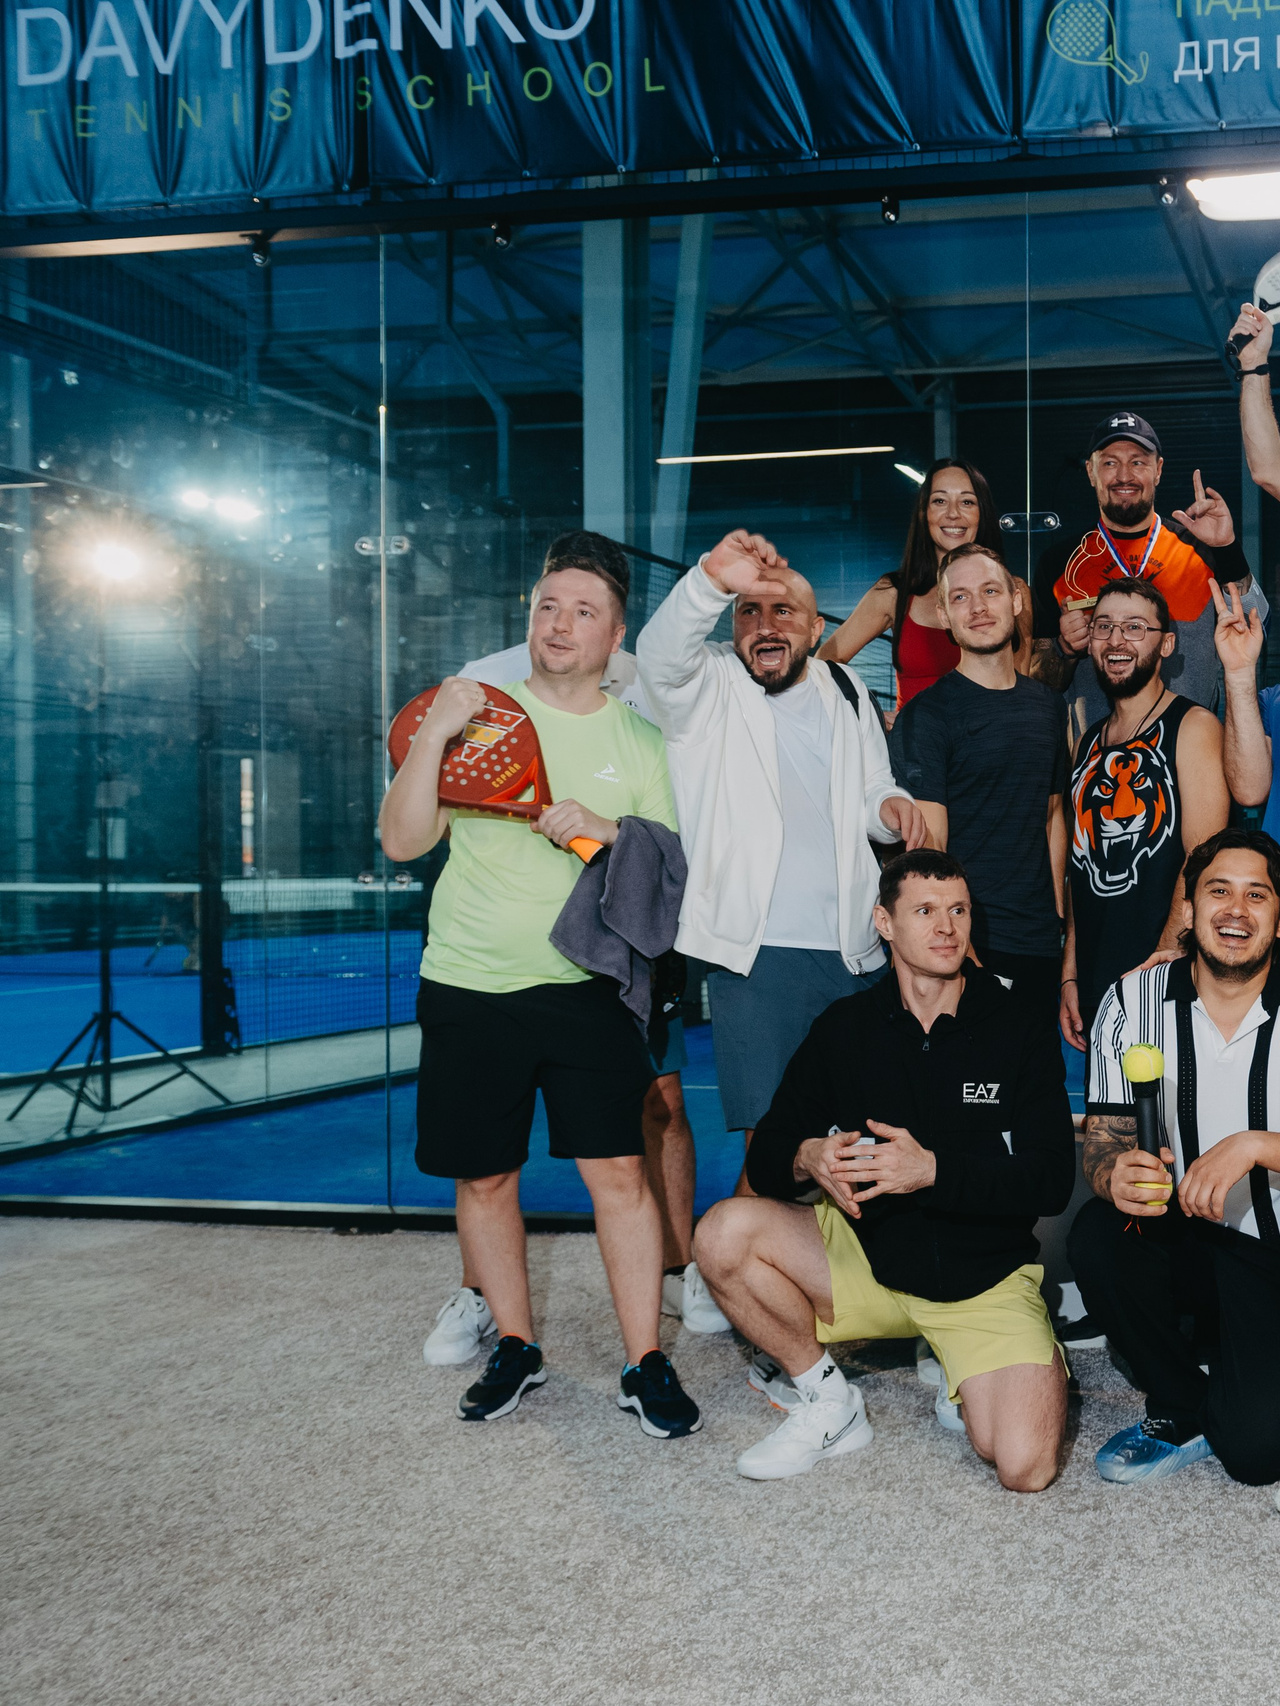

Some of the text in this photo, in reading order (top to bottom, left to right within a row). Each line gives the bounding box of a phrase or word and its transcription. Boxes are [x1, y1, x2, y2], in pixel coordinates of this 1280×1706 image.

[16, 0, 597, 87] DAVYDENKO
[1173, 36, 1261, 84] ДЛЯ
[26, 56, 666, 141] TENNIS SCHOOL
[491, 762, 522, 788] ESPAÑA
[963, 1083, 1000, 1098] EA7
